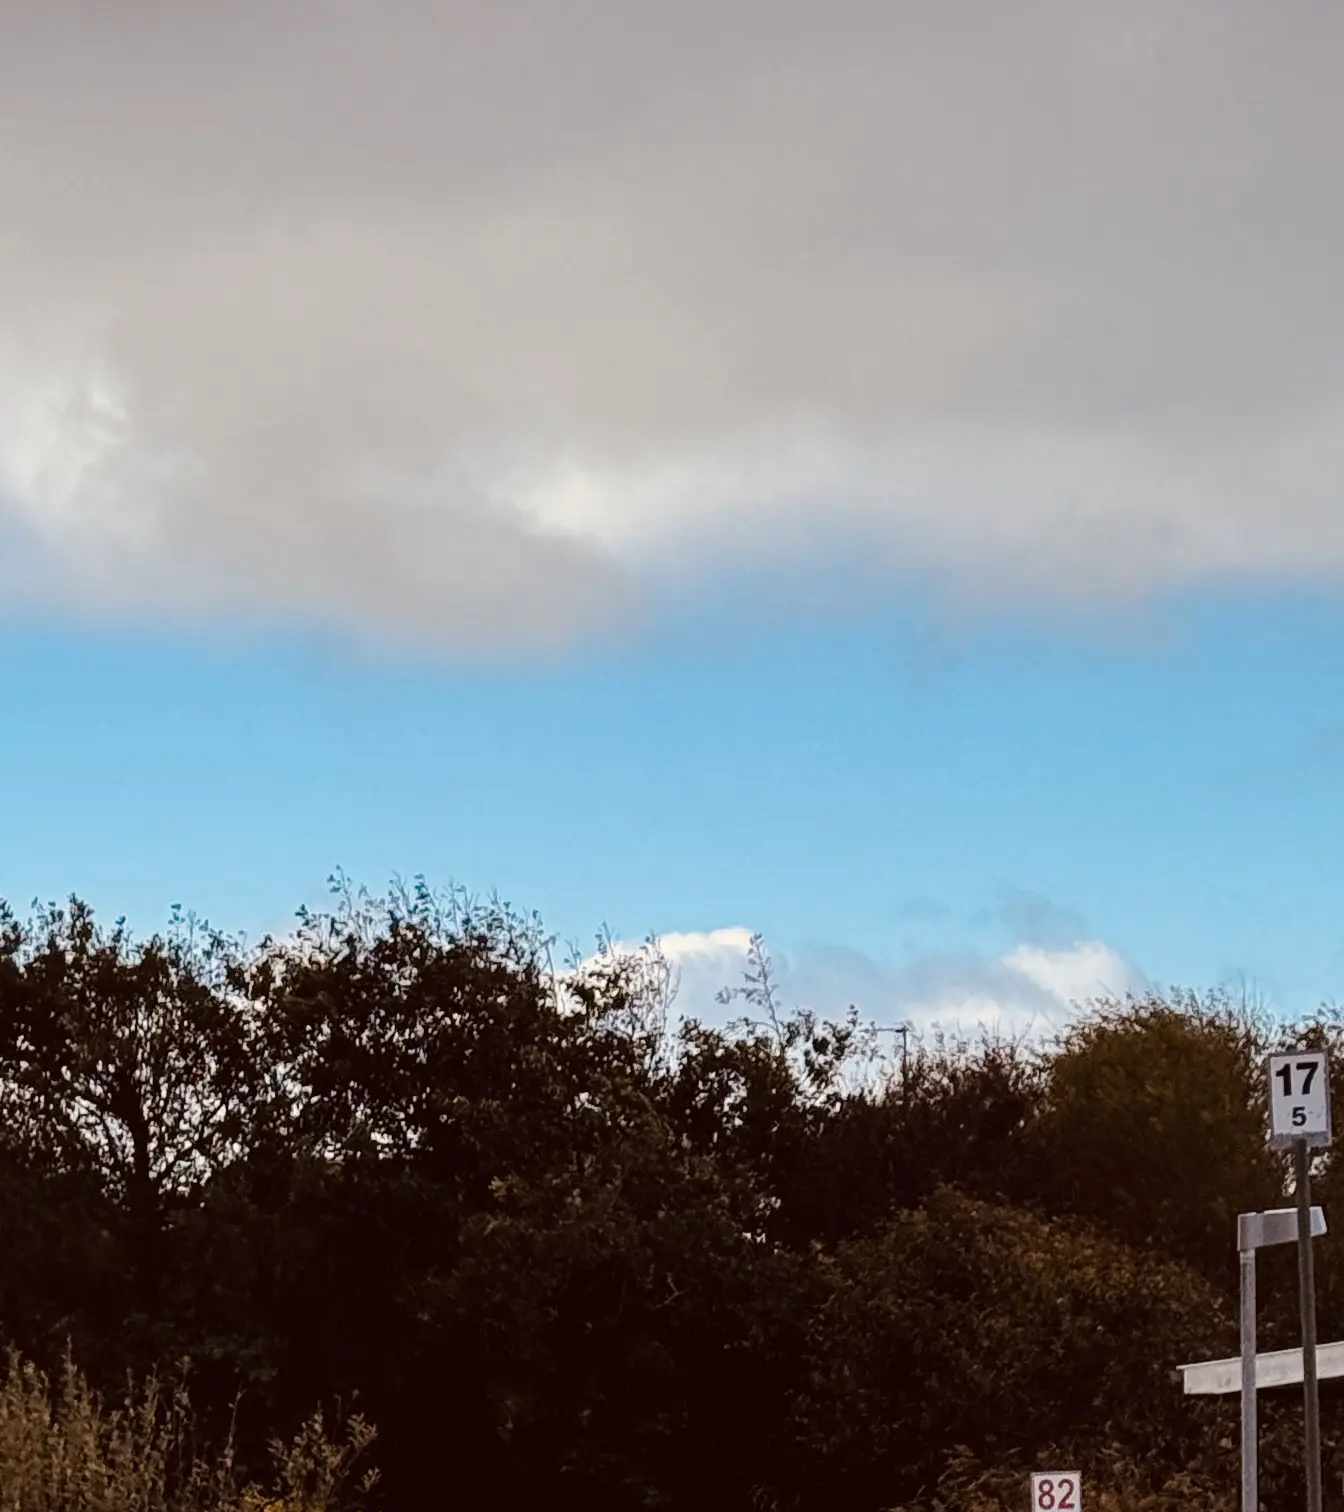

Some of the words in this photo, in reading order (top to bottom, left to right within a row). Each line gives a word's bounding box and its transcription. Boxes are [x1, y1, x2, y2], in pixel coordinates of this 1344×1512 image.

[1275, 1062, 1319, 1096] 17
[1291, 1106, 1307, 1127] 5
[1038, 1478, 1075, 1510] 82
